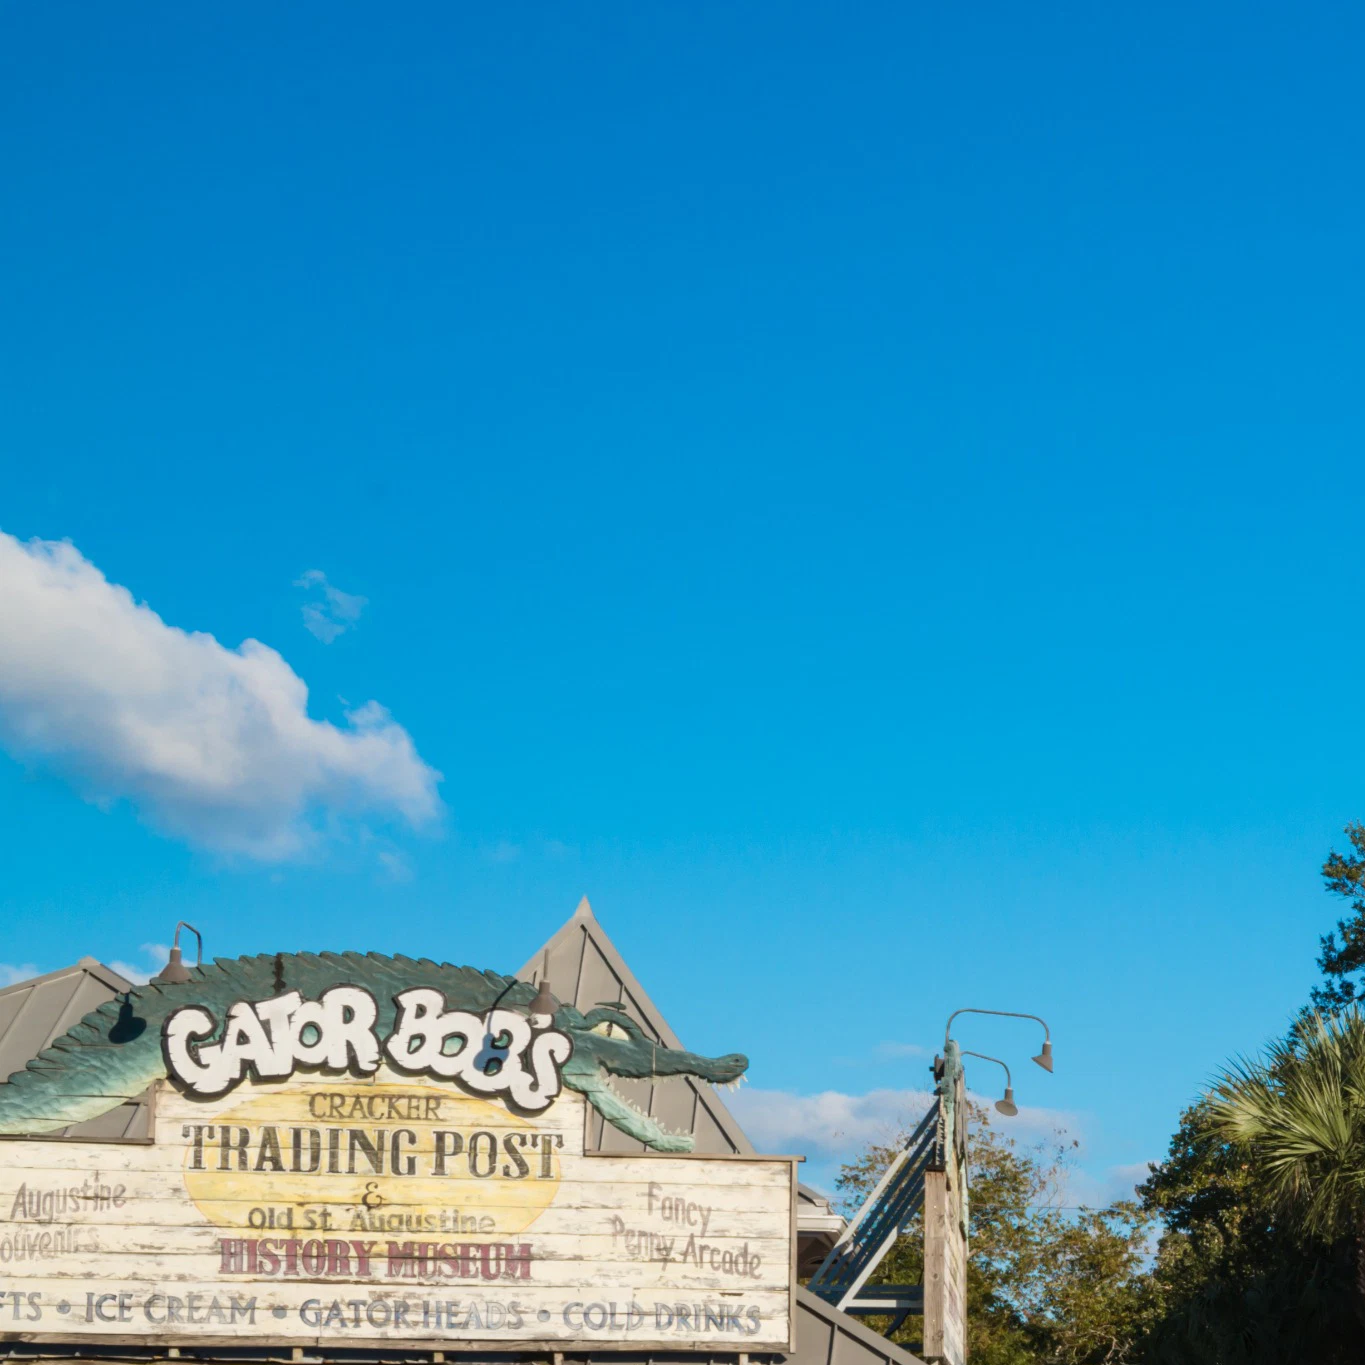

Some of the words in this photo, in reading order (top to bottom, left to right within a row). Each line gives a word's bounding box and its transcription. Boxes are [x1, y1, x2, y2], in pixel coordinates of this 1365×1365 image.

[165, 985, 381, 1095] GATOR
[309, 1092, 441, 1120] CRACKER
[182, 1123, 417, 1176] TRADING
[433, 1130, 565, 1180] POST
[10, 1176, 127, 1225] Augustine
[361, 1182, 384, 1209] &
[640, 1181, 712, 1238] Fancy
[248, 1207, 293, 1230] Old
[349, 1208, 496, 1238] Augustine
[0, 1226, 100, 1263] ouvenirs
[218, 1238, 378, 1277] HISTORY
[384, 1241, 534, 1281] MUSEUM
[610, 1214, 675, 1271] Penny
[683, 1232, 763, 1280] Arcade
[85, 1292, 134, 1323] ICE
[143, 1294, 258, 1325] CREAM
[300, 1298, 412, 1329] GATOR
[422, 1300, 525, 1331] HEADS
[562, 1301, 645, 1332] COLD
[653, 1302, 762, 1335] DRINKS
